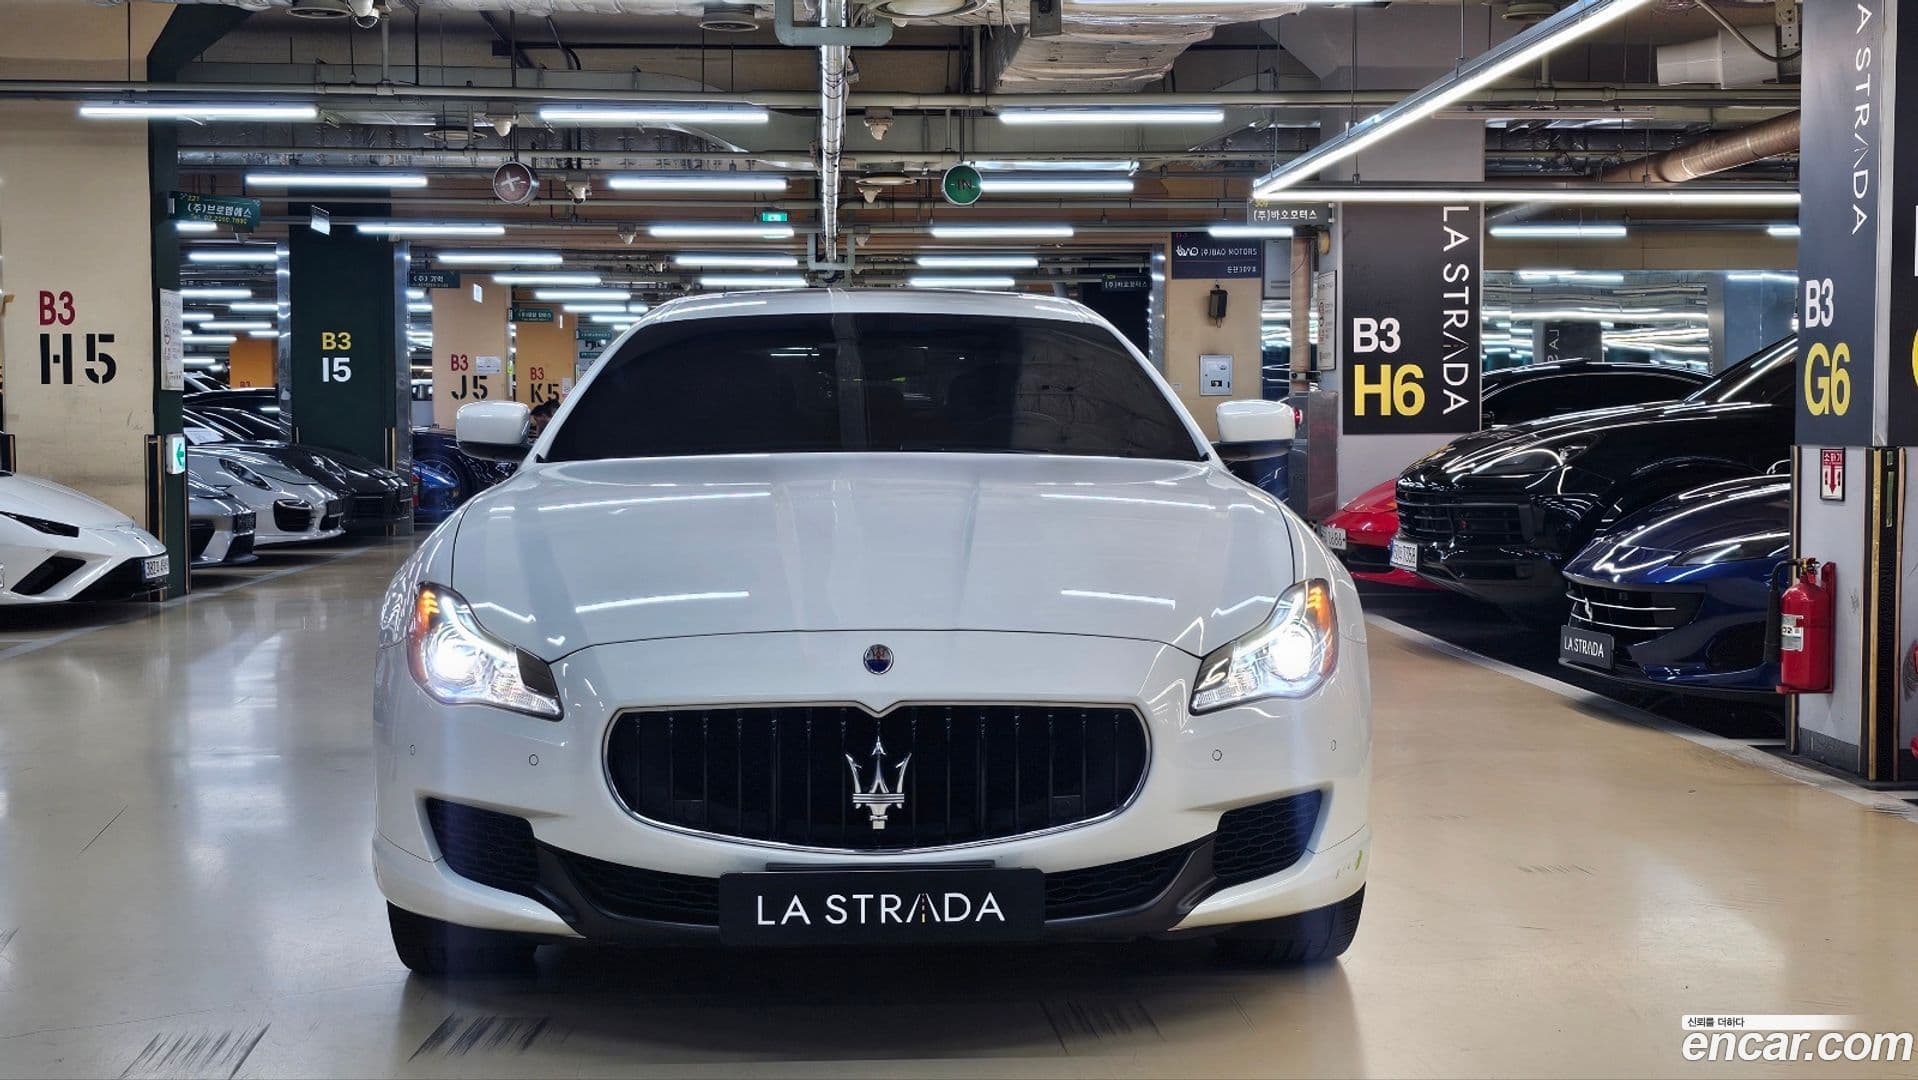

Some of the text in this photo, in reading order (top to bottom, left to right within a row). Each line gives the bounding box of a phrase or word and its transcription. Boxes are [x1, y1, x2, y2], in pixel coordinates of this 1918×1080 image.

[1851, 46, 1872, 235] STRADA
[1253, 209, 1318, 221] (주)바오모터스
[1228, 248, 1258, 256] MOTORS
[40, 290, 76, 326] B3
[1442, 206, 1470, 415] LA STRADA
[1804, 277, 1835, 329] B3
[322, 331, 352, 350] B3
[1353, 317, 1401, 353] B3
[451, 354, 469, 371] B3
[530, 367, 545, 381] B3
[1804, 342, 1851, 416] G6
[1354, 364, 1426, 416] H6
[1563, 636, 1605, 659] LA STRADA
[757, 891, 1006, 926] LA STRADA
